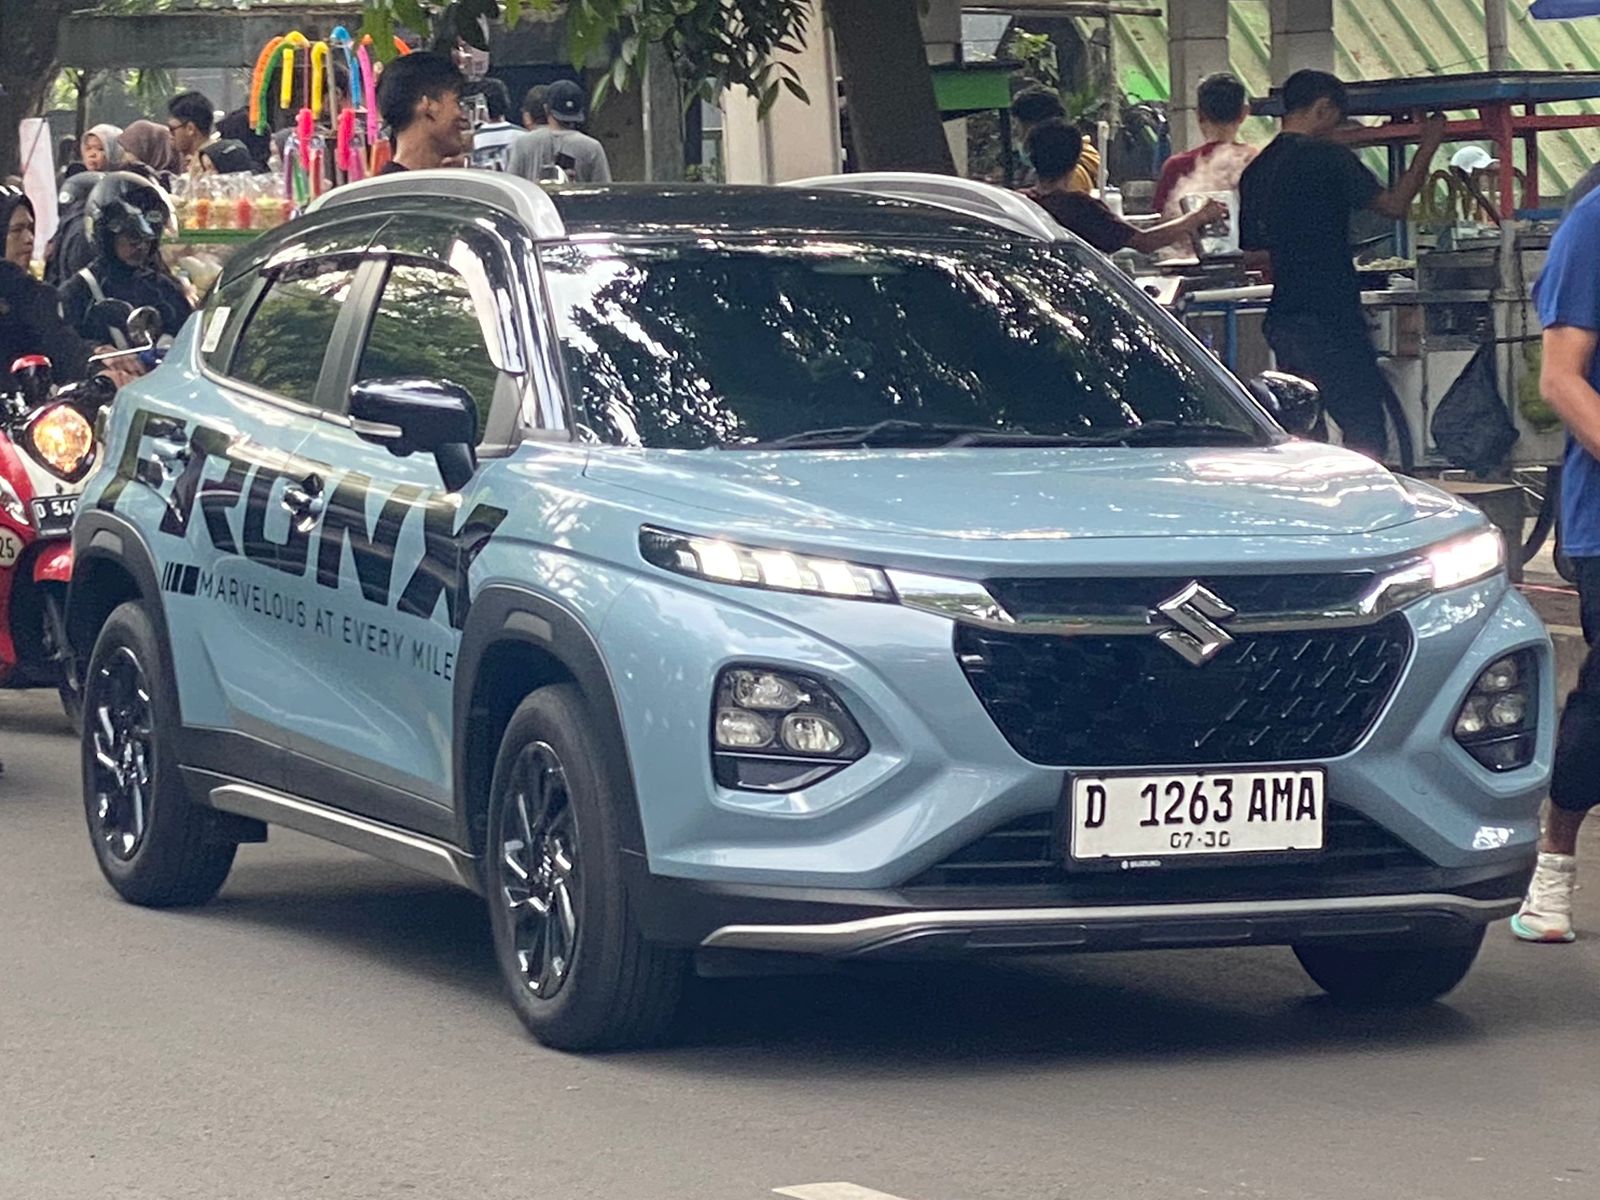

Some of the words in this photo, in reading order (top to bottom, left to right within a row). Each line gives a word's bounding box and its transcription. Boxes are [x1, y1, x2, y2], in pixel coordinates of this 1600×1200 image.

[36, 503, 47, 519] D
[199, 570, 306, 628] MARVELOUS
[315, 607, 334, 638] AT
[343, 615, 404, 660] EVERY
[413, 639, 453, 681] MILE
[1084, 785, 1106, 828] D
[1140, 778, 1234, 827] 1263
[1247, 777, 1317, 823] AMA
